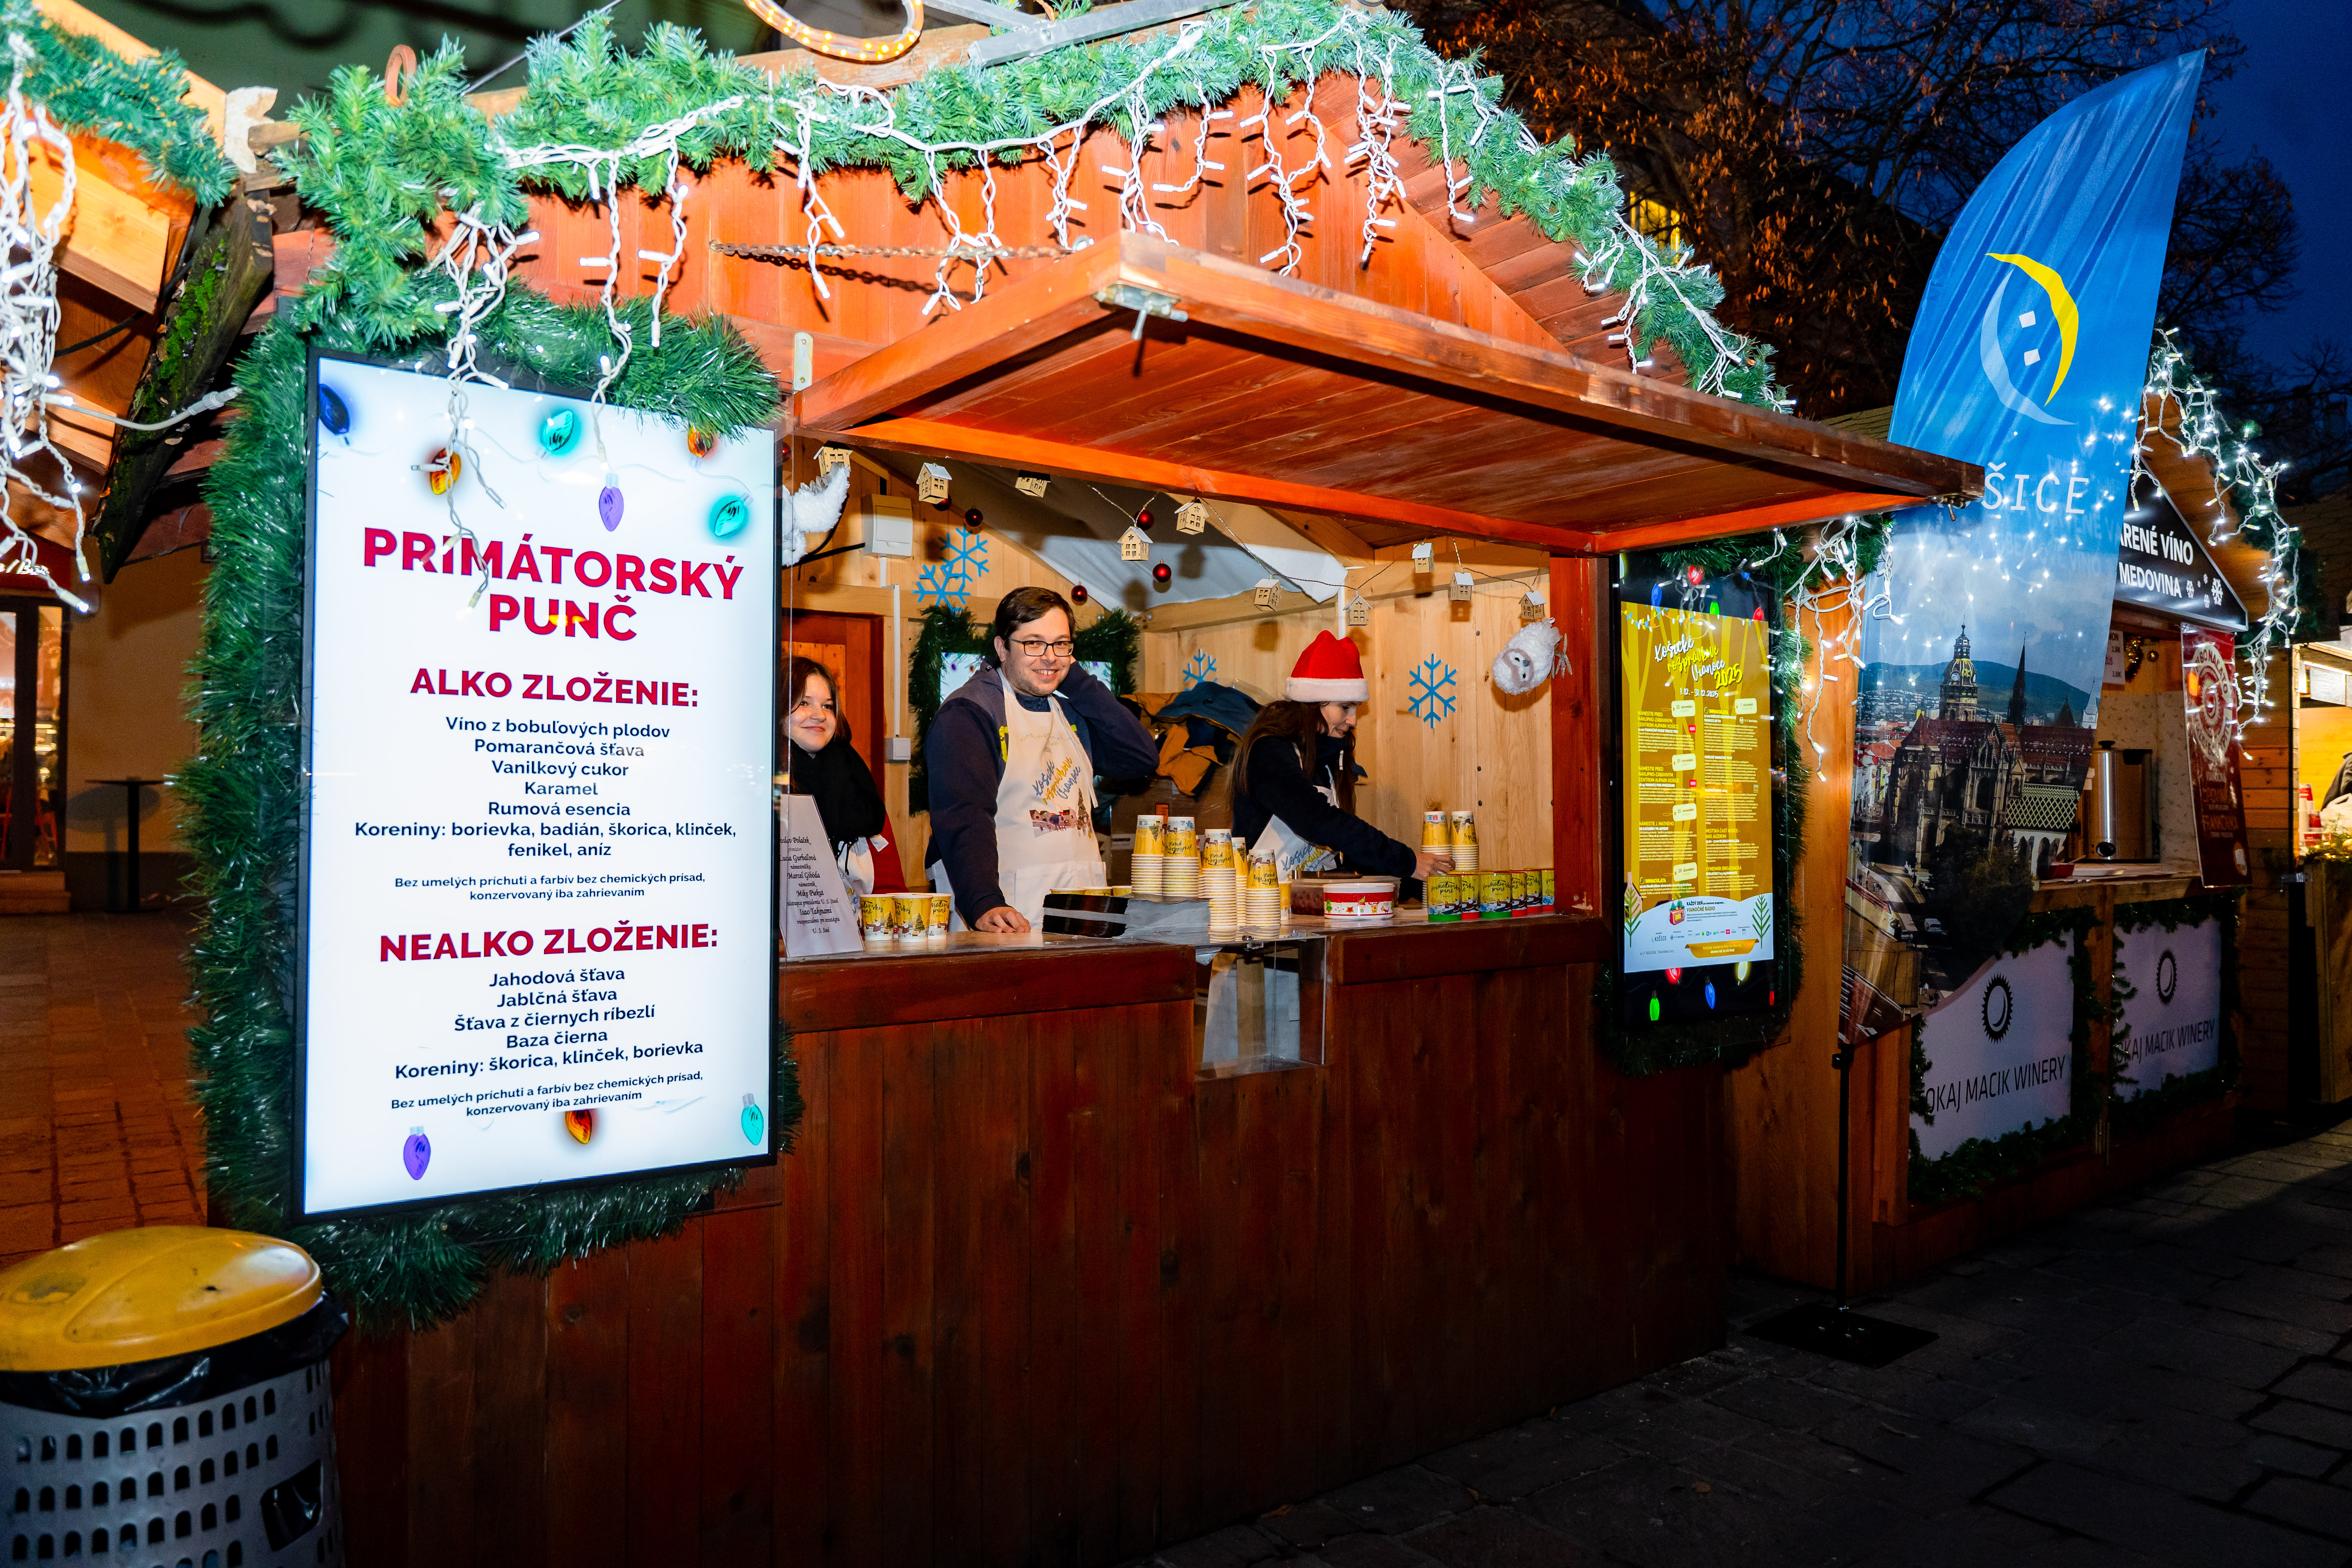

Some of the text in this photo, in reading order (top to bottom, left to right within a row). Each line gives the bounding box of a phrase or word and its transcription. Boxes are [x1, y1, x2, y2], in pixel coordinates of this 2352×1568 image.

[1964, 462, 2089, 514] ŠICE
[2120, 523, 2193, 565] RENÉ VÍNO
[363, 526, 744, 601] PRIMÁTORSKÝ
[2119, 562, 2182, 598] MEDOVINA
[489, 593, 637, 641] PUNČ
[1691, 660, 1726, 681] Vianoce
[1714, 663, 1743, 689] 2025
[410, 668, 697, 707] ALKO ZLOŽENIE:
[446, 717, 670, 739] Víno z bobuľových plodov
[475, 739, 644, 756] Pomarančová šťava
[492, 760, 629, 779] Vanilkový cukor
[525, 782, 598, 795] Karamel
[489, 802, 630, 815] Rumová esencia
[356, 822, 736, 840] Koreniny: borievka, badián, škorica, klinček,
[508, 842, 611, 858] fenikel, aníz
[395, 878, 417, 887] Bez
[422, 877, 476, 889] umelých
[480, 876, 526, 888] príchuti
[540, 875, 574, 884] farbív
[577, 875, 597, 884] bez
[600, 873, 666, 885] chemických
[670, 873, 705, 884] prísad,
[804, 871, 820, 880] Gibóda
[470, 888, 644, 901] konzervovaný iba zahrievaním
[809, 889, 824, 898] Piekut
[380, 920, 717, 962] NEALKO ZLOŽENIE:
[489, 968, 625, 987] Jahodová šťava
[497, 989, 617, 1007] Jablčná šťava
[454, 1004, 655, 1031] Šťava z čiernych ríbezlí
[507, 1031, 608, 1049] Baza čierna
[2145, 1028, 2175, 1057] MACIK
[2177, 1018, 2216, 1047] WINERY
[396, 1041, 703, 1079] Koreniny: škorica, klinček, borievka
[392, 1100, 414, 1109] Bez
[418, 1093, 472, 1106] umelých
[476, 1088, 523, 1103] príchuti
[537, 1084, 571, 1095] farbív
[574, 1082, 594, 1091] bez
[597, 1075, 664, 1089] chemických
[667, 1071, 702, 1085] prísad,
[1965, 1069, 2010, 1104] MACIK
[2014, 1055, 2065, 1091] WINERY
[466, 1093, 642, 1116] konzervovaný iba zahrievaním
